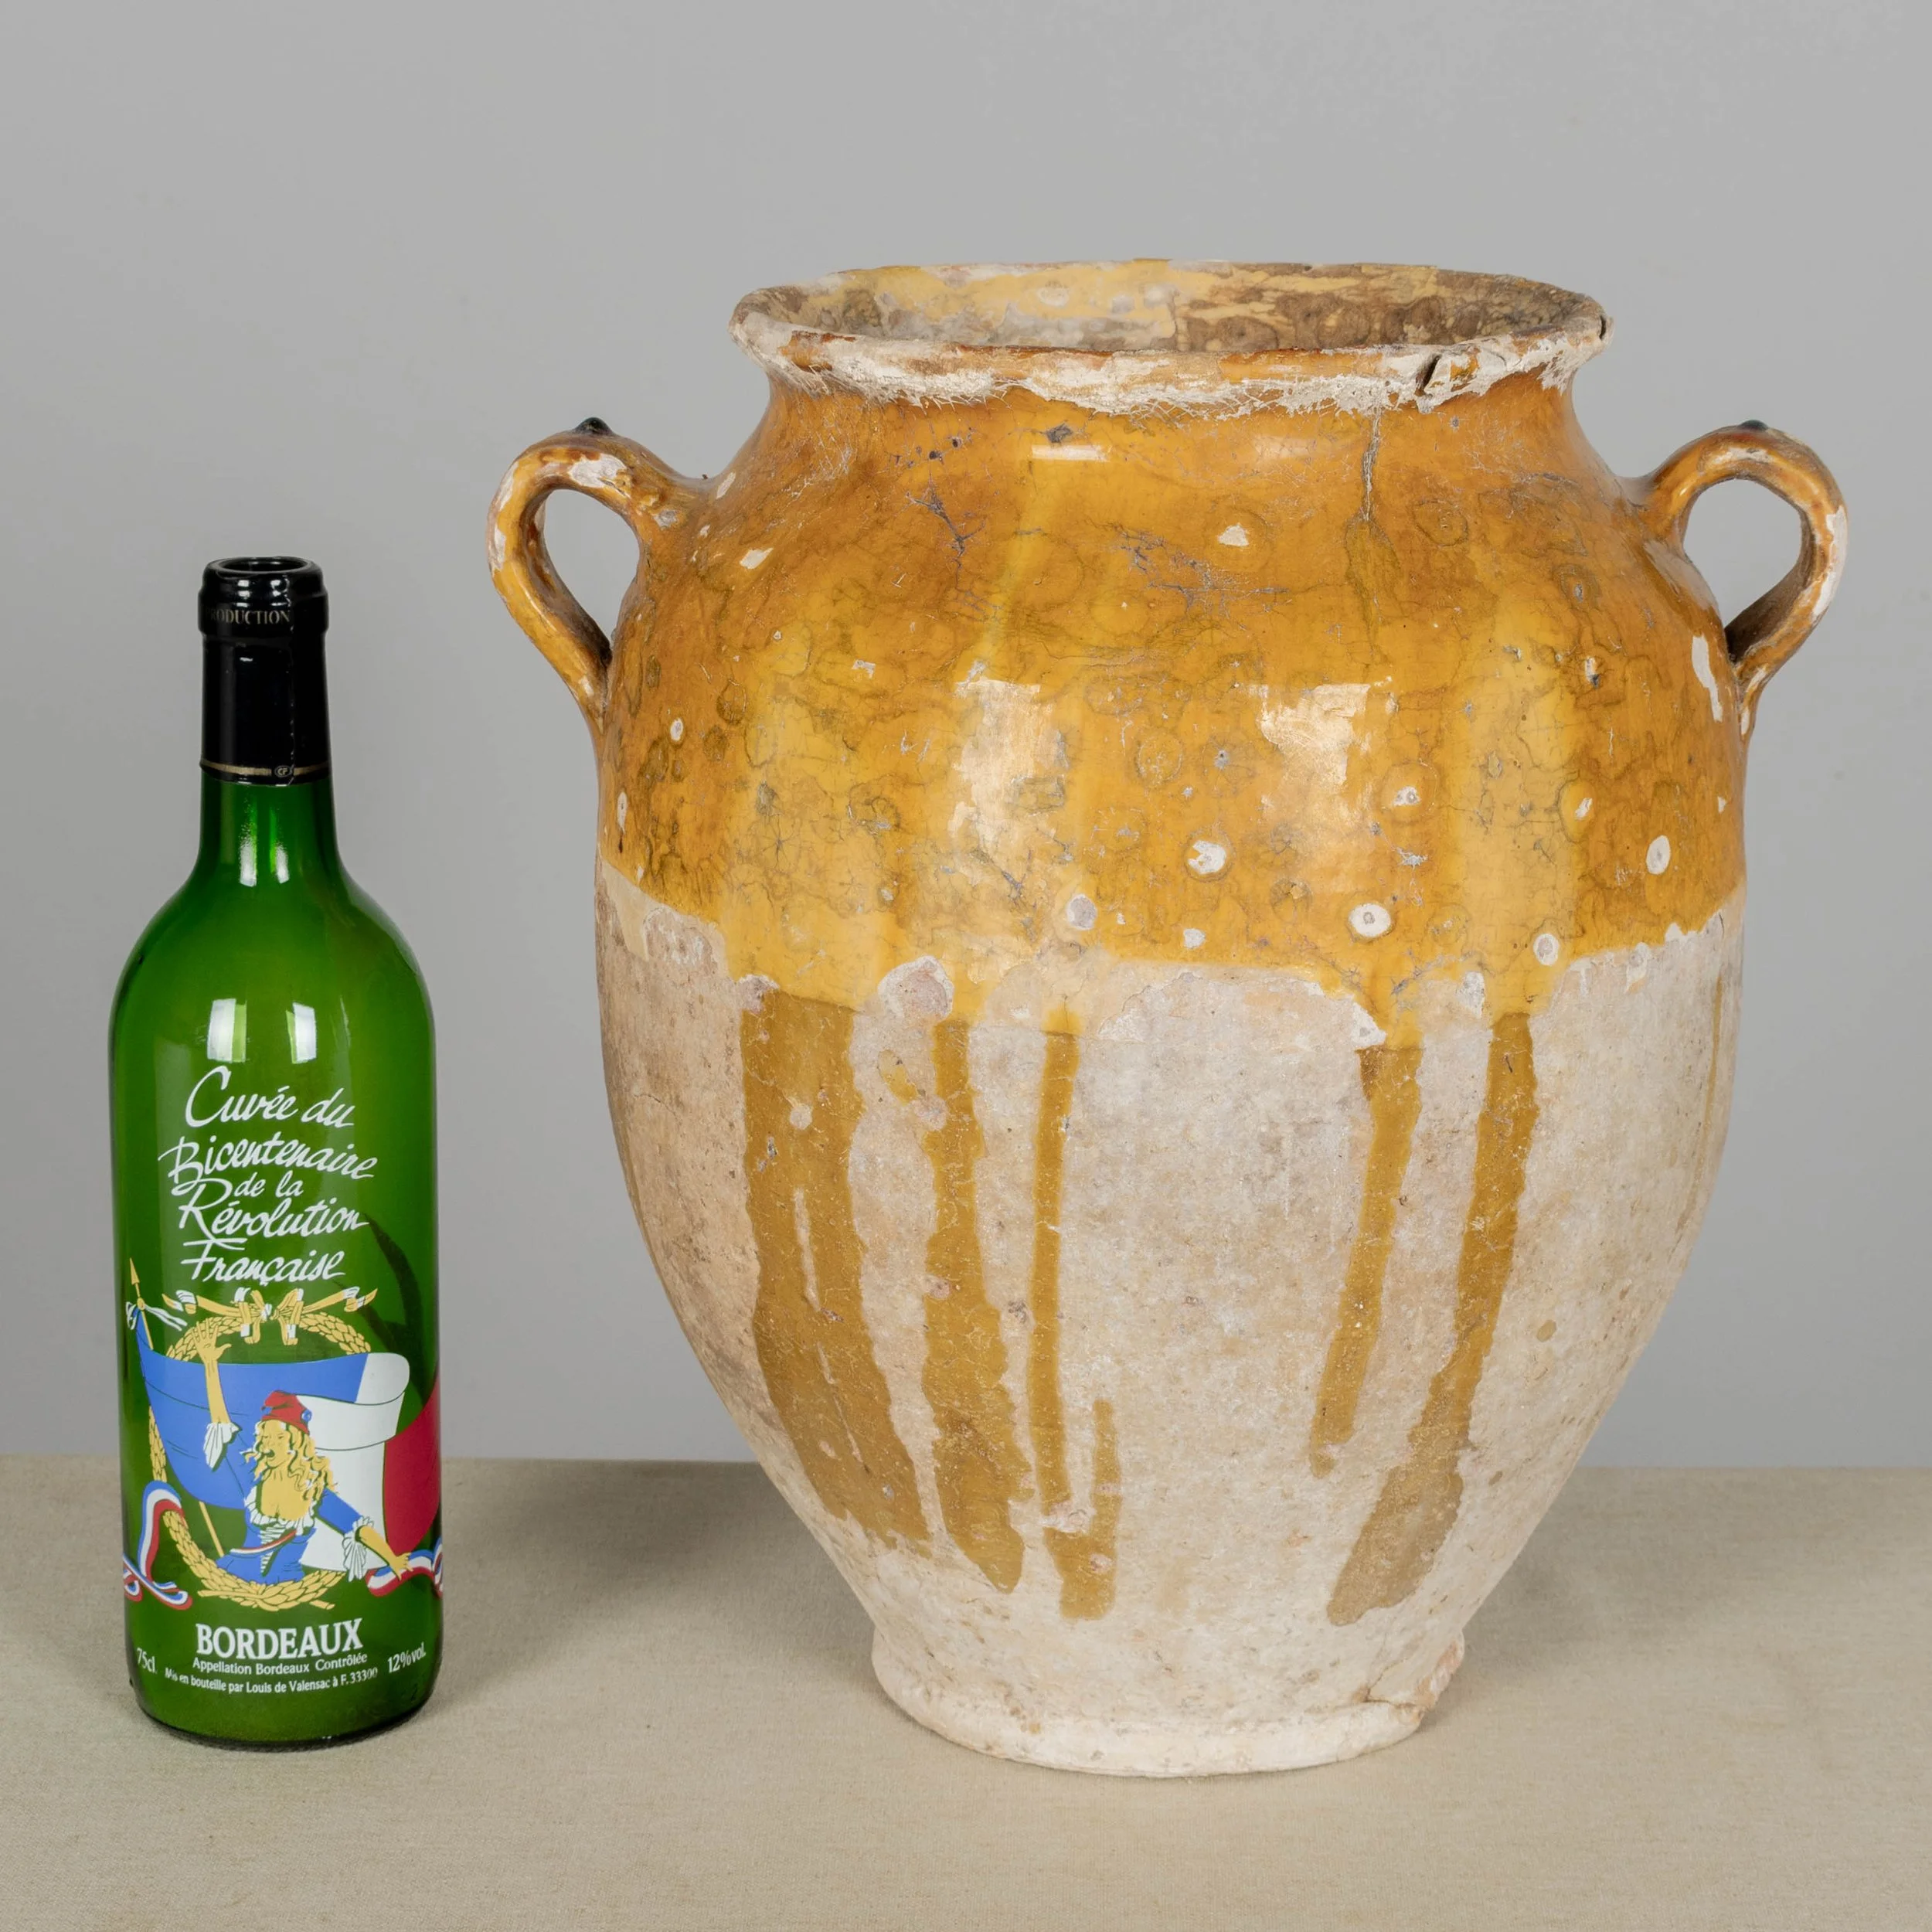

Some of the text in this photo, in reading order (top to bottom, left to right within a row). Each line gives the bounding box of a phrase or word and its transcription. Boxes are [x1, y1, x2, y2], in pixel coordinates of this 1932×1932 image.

[185, 1066, 355, 1128] Cuvée du
[158, 1131, 378, 1184] Bicentenaire
[234, 1170, 304, 1198] de la
[171, 1178, 369, 1250] Révolution
[181, 1238, 345, 1286] Française
[196, 1617, 363, 1660] BORDEAUX
[179, 1674, 189, 1685] en
[191, 1675, 226, 1692] bouteille
[229, 1683, 244, 1694] par
[247, 1682, 272, 1693] Louis
[274, 1681, 287, 1692] de
[289, 1678, 331, 1692] Valensac
[332, 1675, 338, 1687] à
[192, 1652, 368, 1675] Appellation Bordeaux Contrôlée
